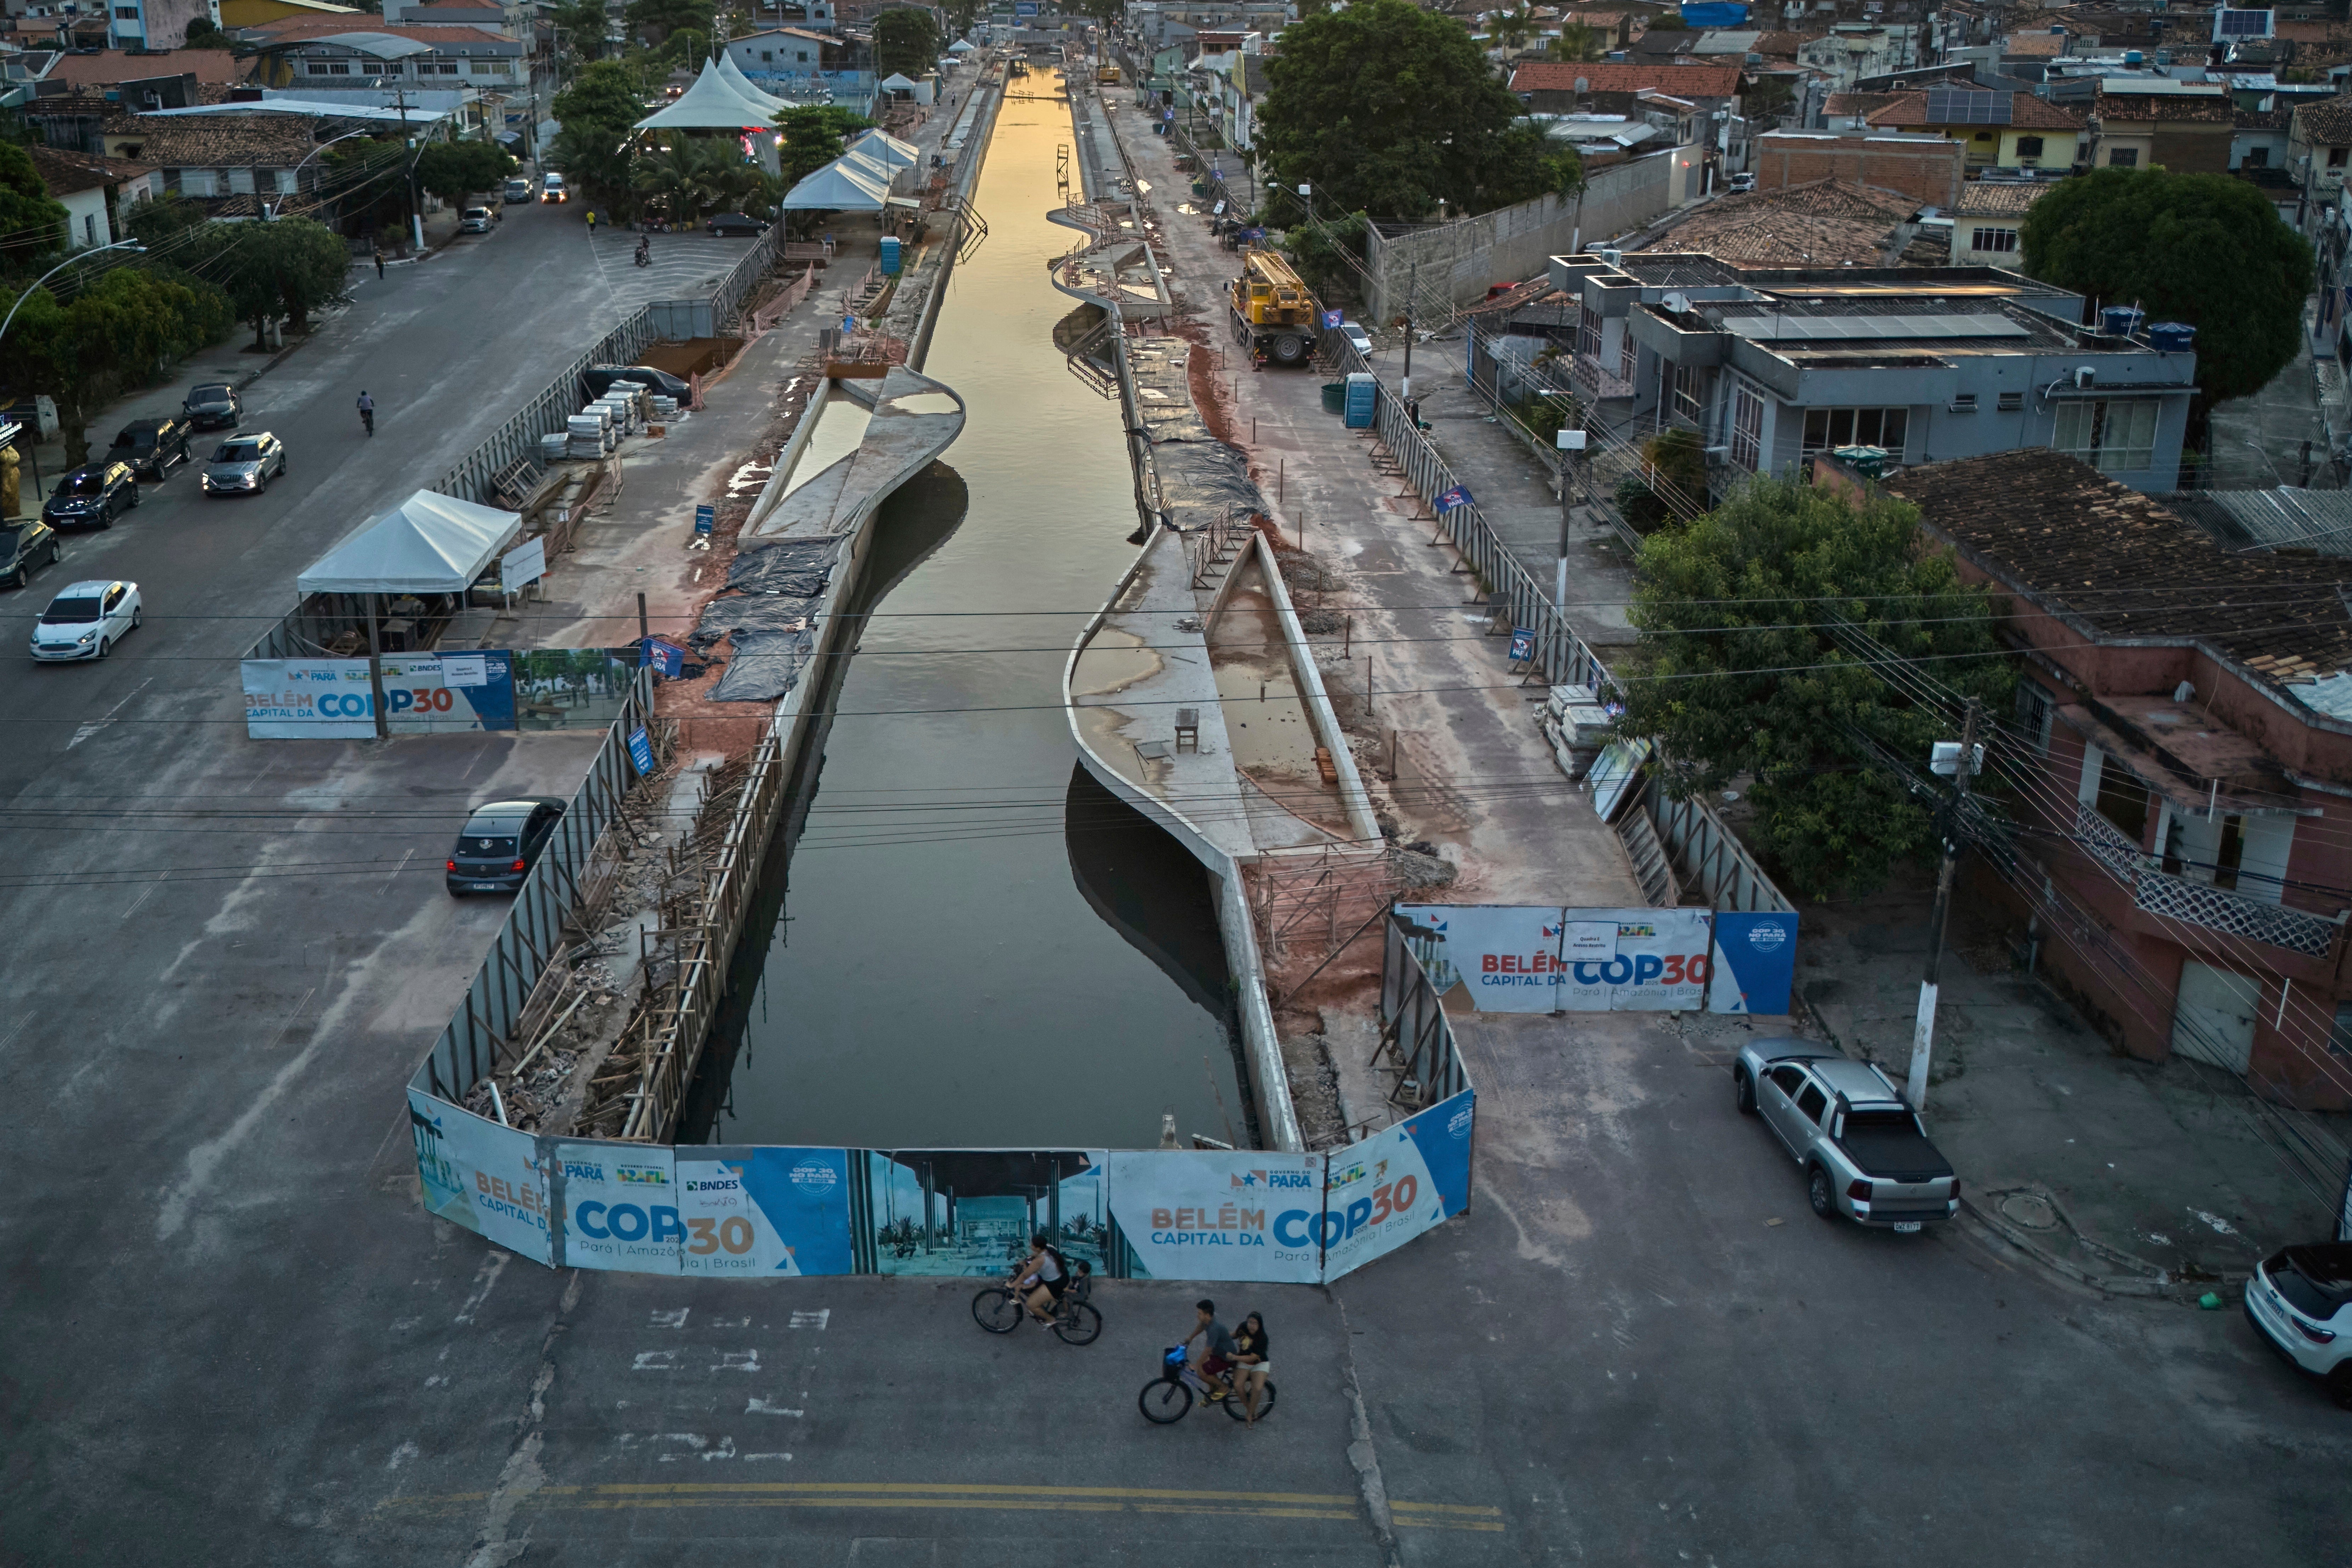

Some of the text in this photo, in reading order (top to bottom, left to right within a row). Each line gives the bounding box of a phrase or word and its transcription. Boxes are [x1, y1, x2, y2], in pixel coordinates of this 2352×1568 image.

[245, 690, 313, 707] BELÉM
[246, 709, 314, 717] CAPITAL DA
[1482, 950, 1567, 973] BELÉM
[1573, 954, 1715, 986] COP30
[1482, 975, 1566, 986] CAPITAL DA
[1573, 987, 1600, 996] Pará
[1612, 987, 1667, 996] Amazônia
[565, 1164, 605, 1181] PARÁ
[1346, 1161, 1363, 1169] FEDERAL
[700, 1180, 738, 1191] BNDES
[1269, 1175, 1312, 1188] PARÁ
[479, 1194, 534, 1225] CAPITAL
[1151, 1202, 1265, 1231] BELÉM
[1273, 1174, 1417, 1250] COP30
[575, 1200, 754, 1255] COP30
[1275, 1210, 1415, 1262] Pará Amazônia Brasil
[1354, 1223, 1368, 1236] 2025
[1151, 1232, 1265, 1246] CAPITAL DA
[580, 1240, 612, 1254] Pará
[713, 1258, 756, 1268] Brasil
